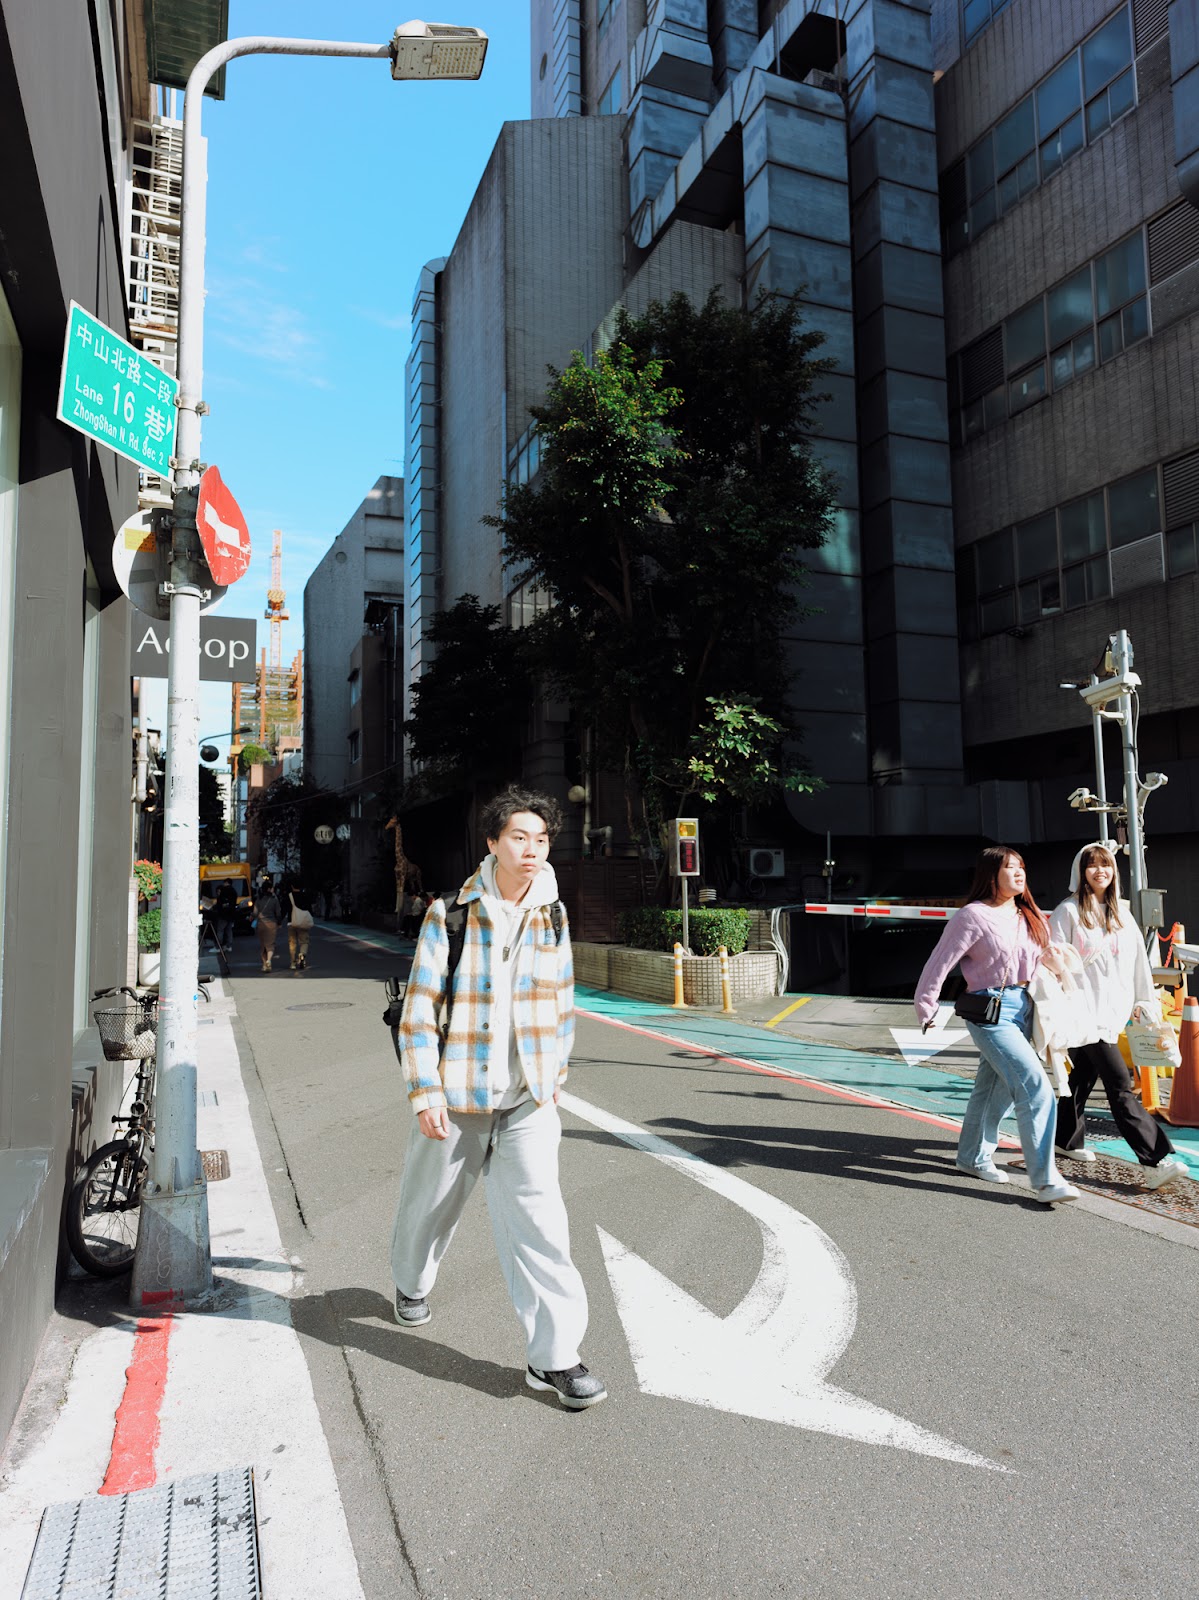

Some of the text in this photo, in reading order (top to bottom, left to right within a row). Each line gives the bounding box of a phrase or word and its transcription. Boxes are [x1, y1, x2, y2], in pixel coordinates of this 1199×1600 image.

[76, 323, 172, 407] 中山北路二段
[73, 398, 164, 466] ZhongShan N. Rd. Sec. 2
[75, 374, 166, 443] Lane 16 巷
[136, 626, 249, 669] Aop
